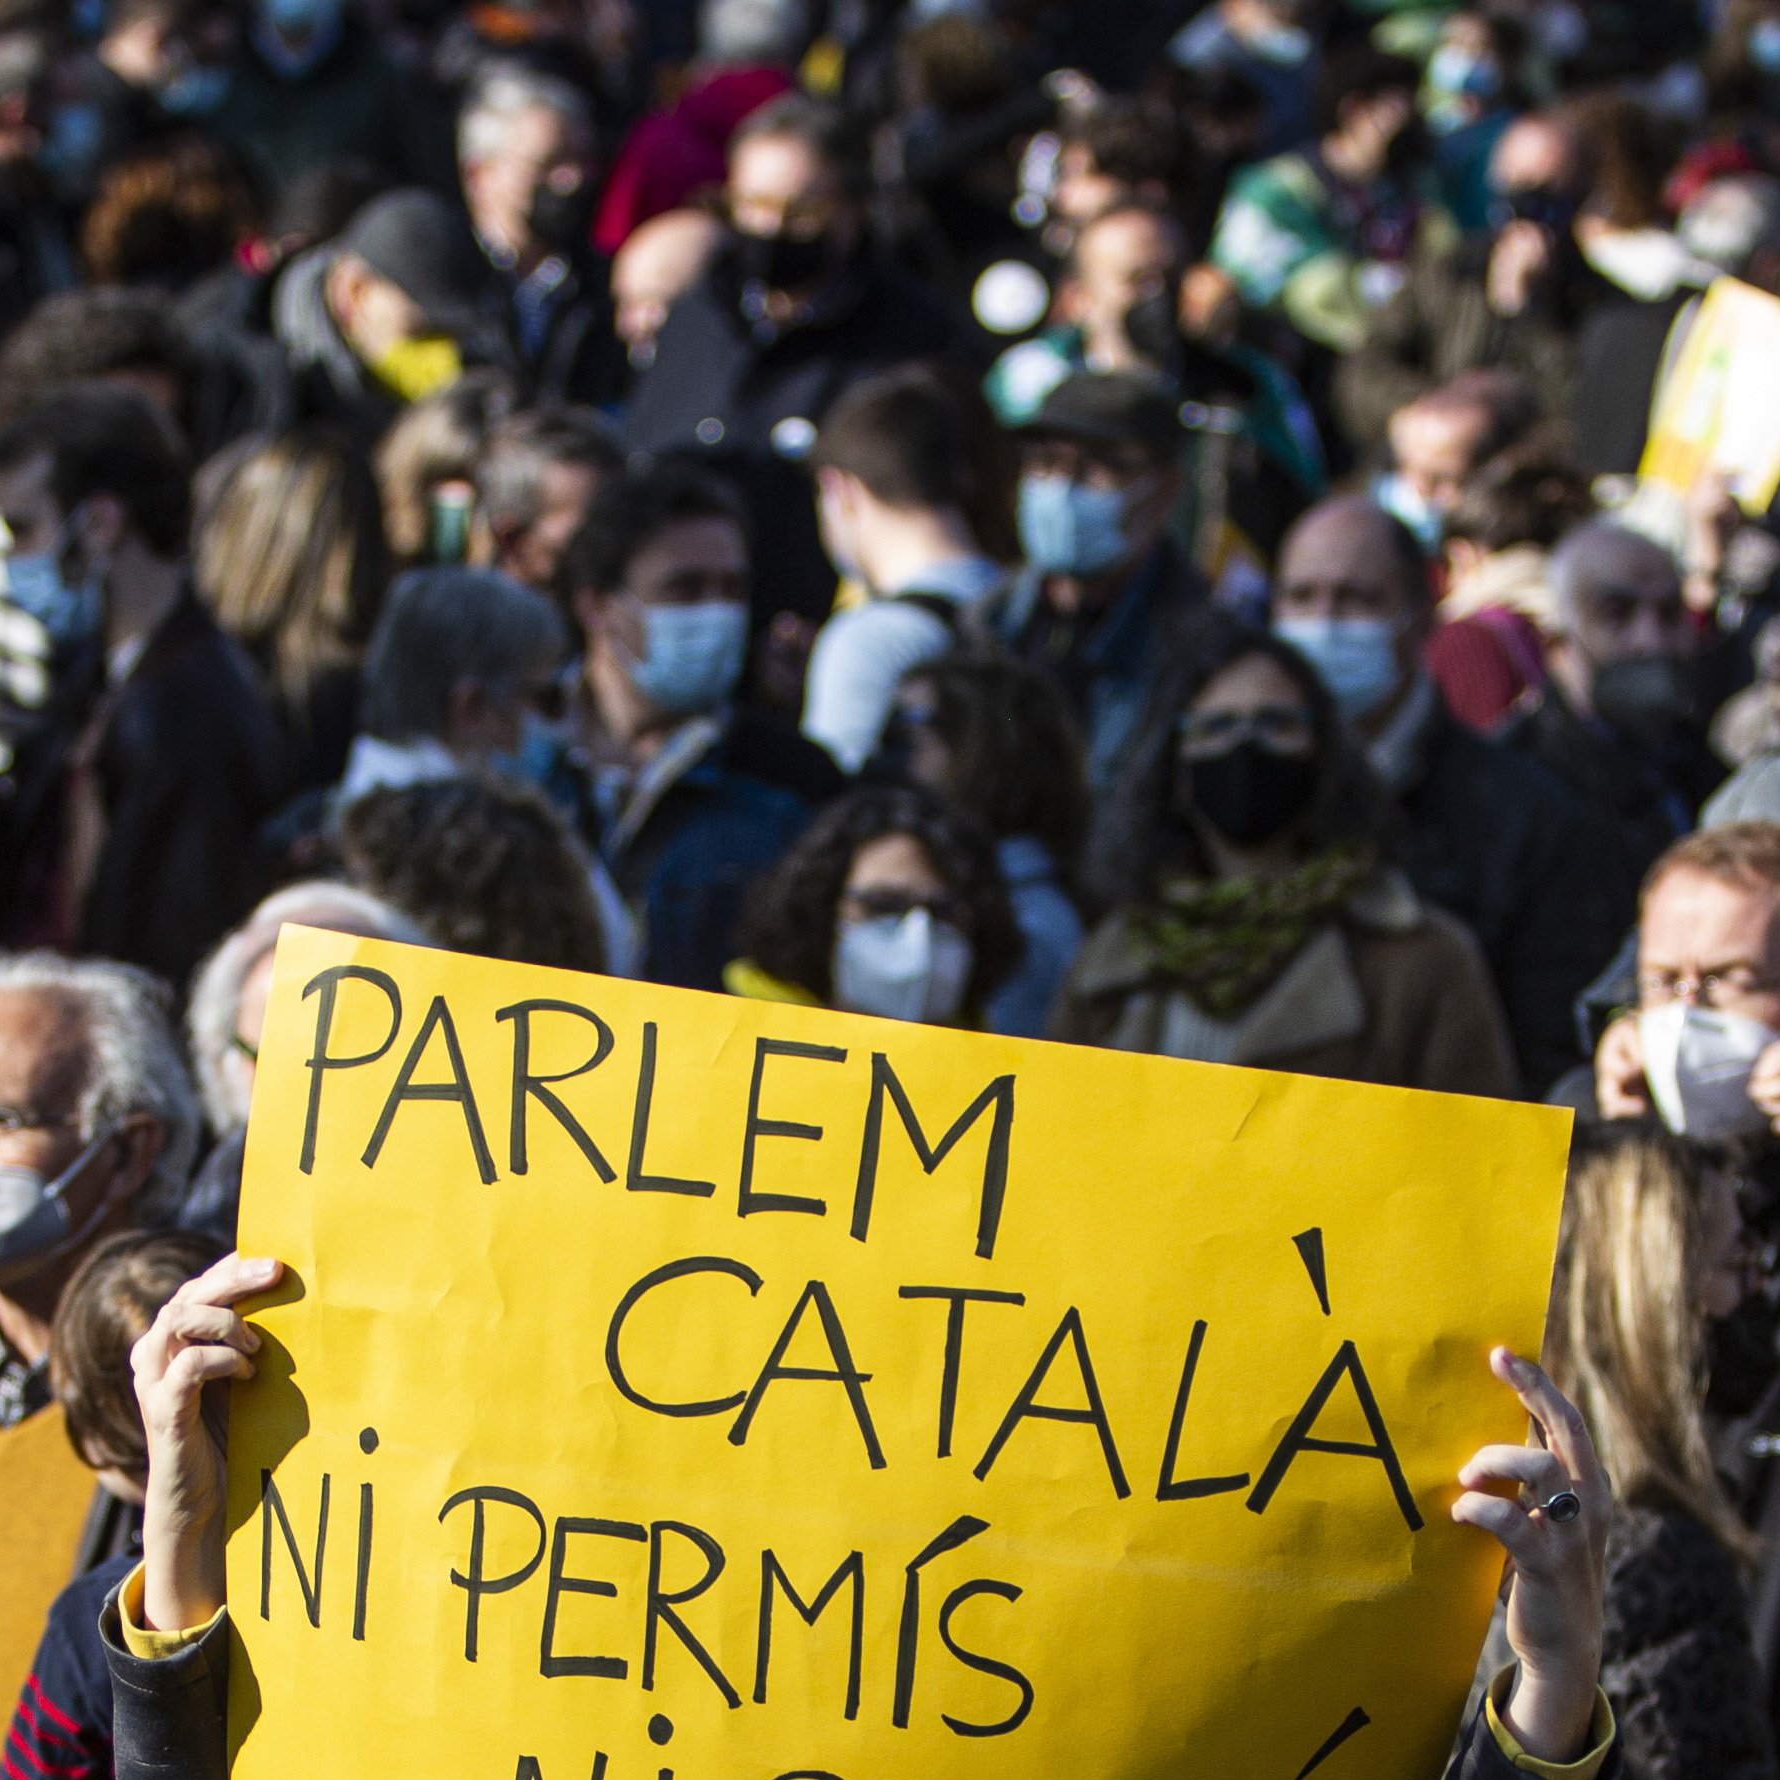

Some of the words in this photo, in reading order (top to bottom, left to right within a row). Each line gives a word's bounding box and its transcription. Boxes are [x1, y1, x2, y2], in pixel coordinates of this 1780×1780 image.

[299, 964, 1016, 1260] PARLEM
[605, 1226, 1425, 1532] CATALÀ
[437, 1485, 1035, 1738] PERMÍS
